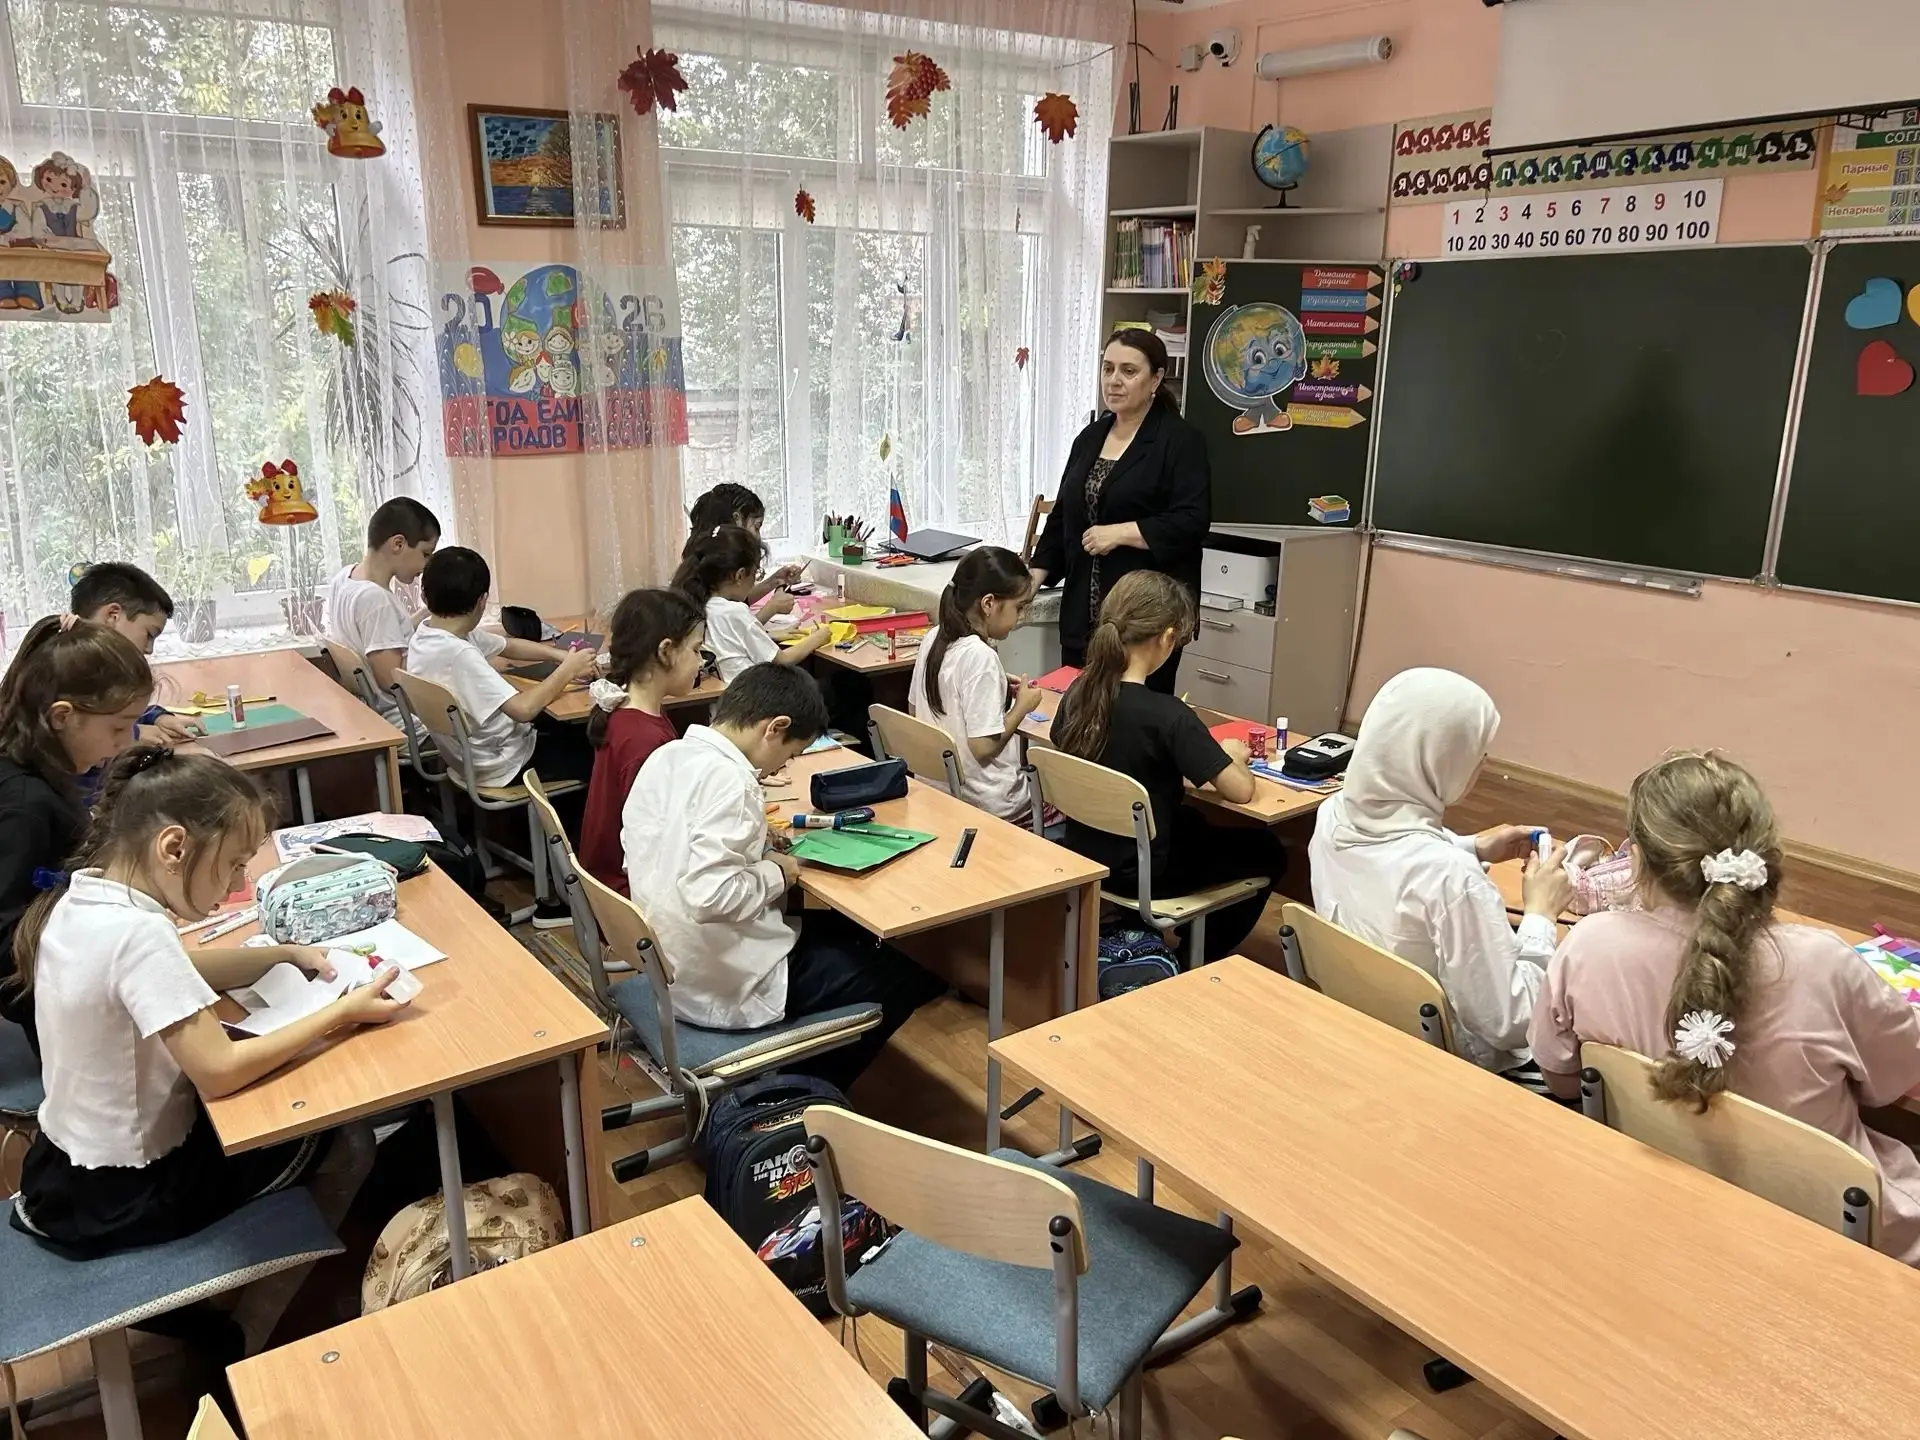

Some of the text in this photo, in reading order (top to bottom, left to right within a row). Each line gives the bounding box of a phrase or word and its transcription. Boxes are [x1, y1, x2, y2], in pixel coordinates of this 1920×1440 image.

[1420, 134, 1429, 146] О
[1501, 167, 1511, 180] П
[1547, 162, 1558, 176] К
[1571, 160, 1581, 173] Т
[1596, 156, 1607, 170] Ш
[1621, 154, 1631, 167] С
[1648, 151, 1659, 165] Х
[1676, 148, 1687, 164] Ц
[1705, 145, 1716, 159] Ч
[1841, 164, 1889, 175] Парные
[1453, 190, 1706, 224] 1 2 3 4 5 6 7 8 9 10
[1828, 206, 1886, 216] Непарные
[1447, 221, 1710, 252] 10 20 30 40 50 60 70 80 90 100
[1313, 269, 1356, 279] Домашнее
[1304, 319, 1360, 329] Математика
[750, 1152, 789, 1175] TAK
[752, 1166, 793, 1182] THE RA
